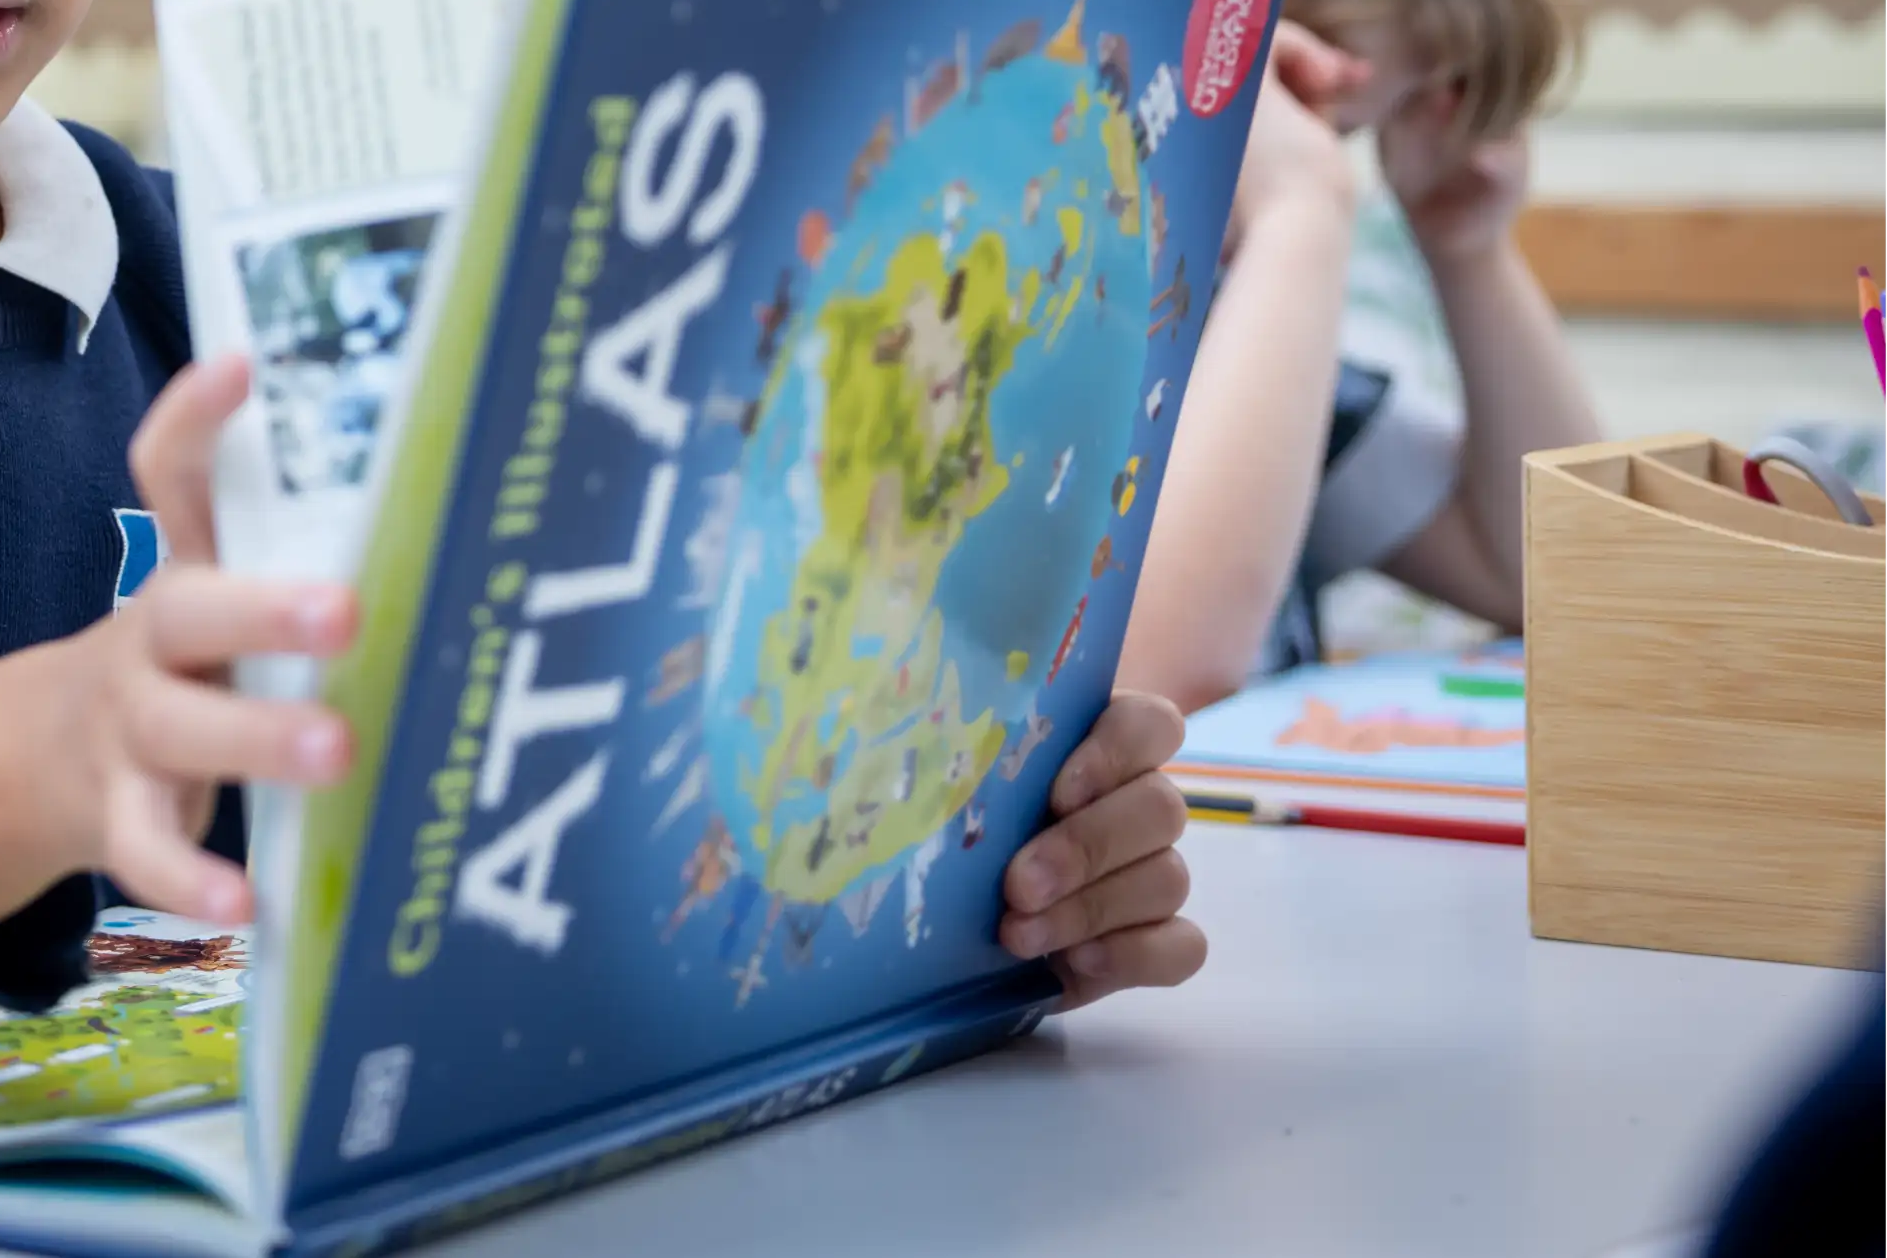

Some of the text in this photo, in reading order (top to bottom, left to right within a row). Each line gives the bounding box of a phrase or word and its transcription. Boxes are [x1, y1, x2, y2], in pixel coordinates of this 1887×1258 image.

[388, 94, 639, 977] Children's Illustrated
[452, 70, 765, 955] ATLAS
